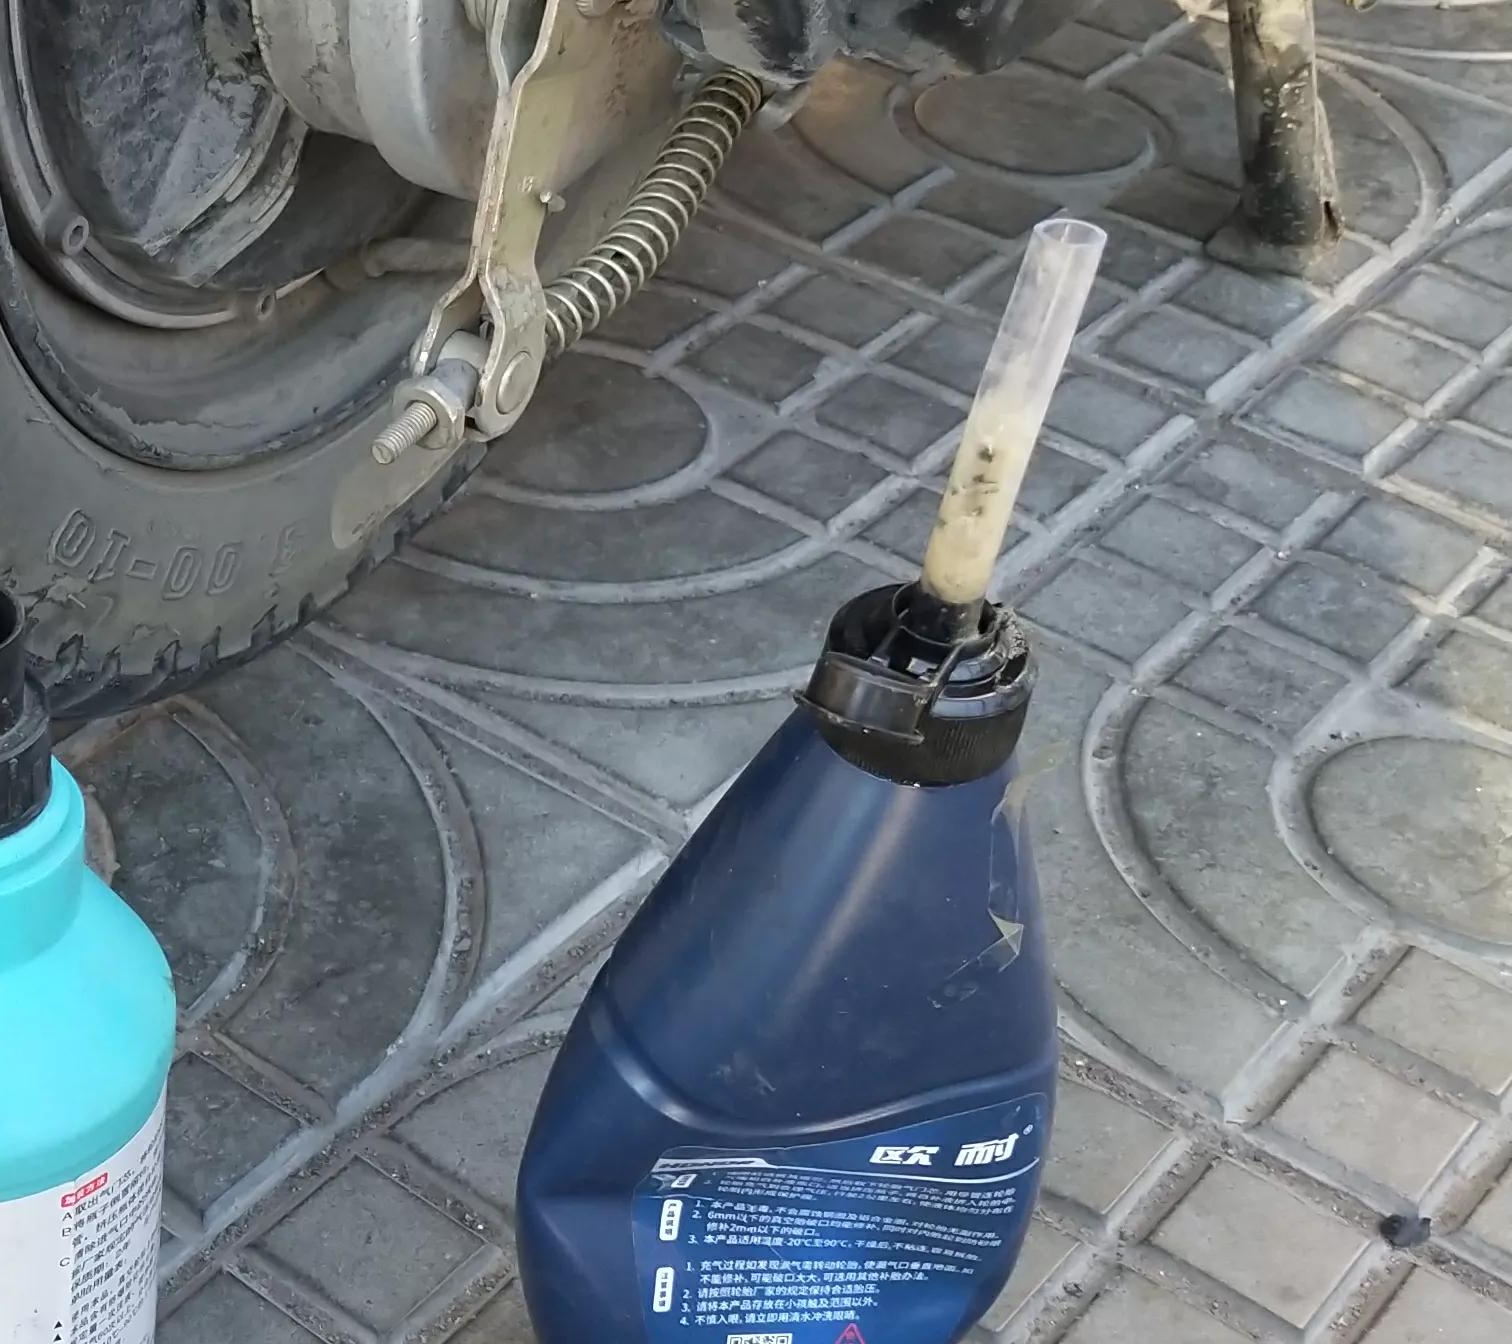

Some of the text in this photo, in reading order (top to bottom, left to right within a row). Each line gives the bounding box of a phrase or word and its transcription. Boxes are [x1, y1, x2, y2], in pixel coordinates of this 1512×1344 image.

[62, 1212, 73, 1221] A
[62, 1227, 72, 1237] B
[59, 1257, 70, 1267] C
